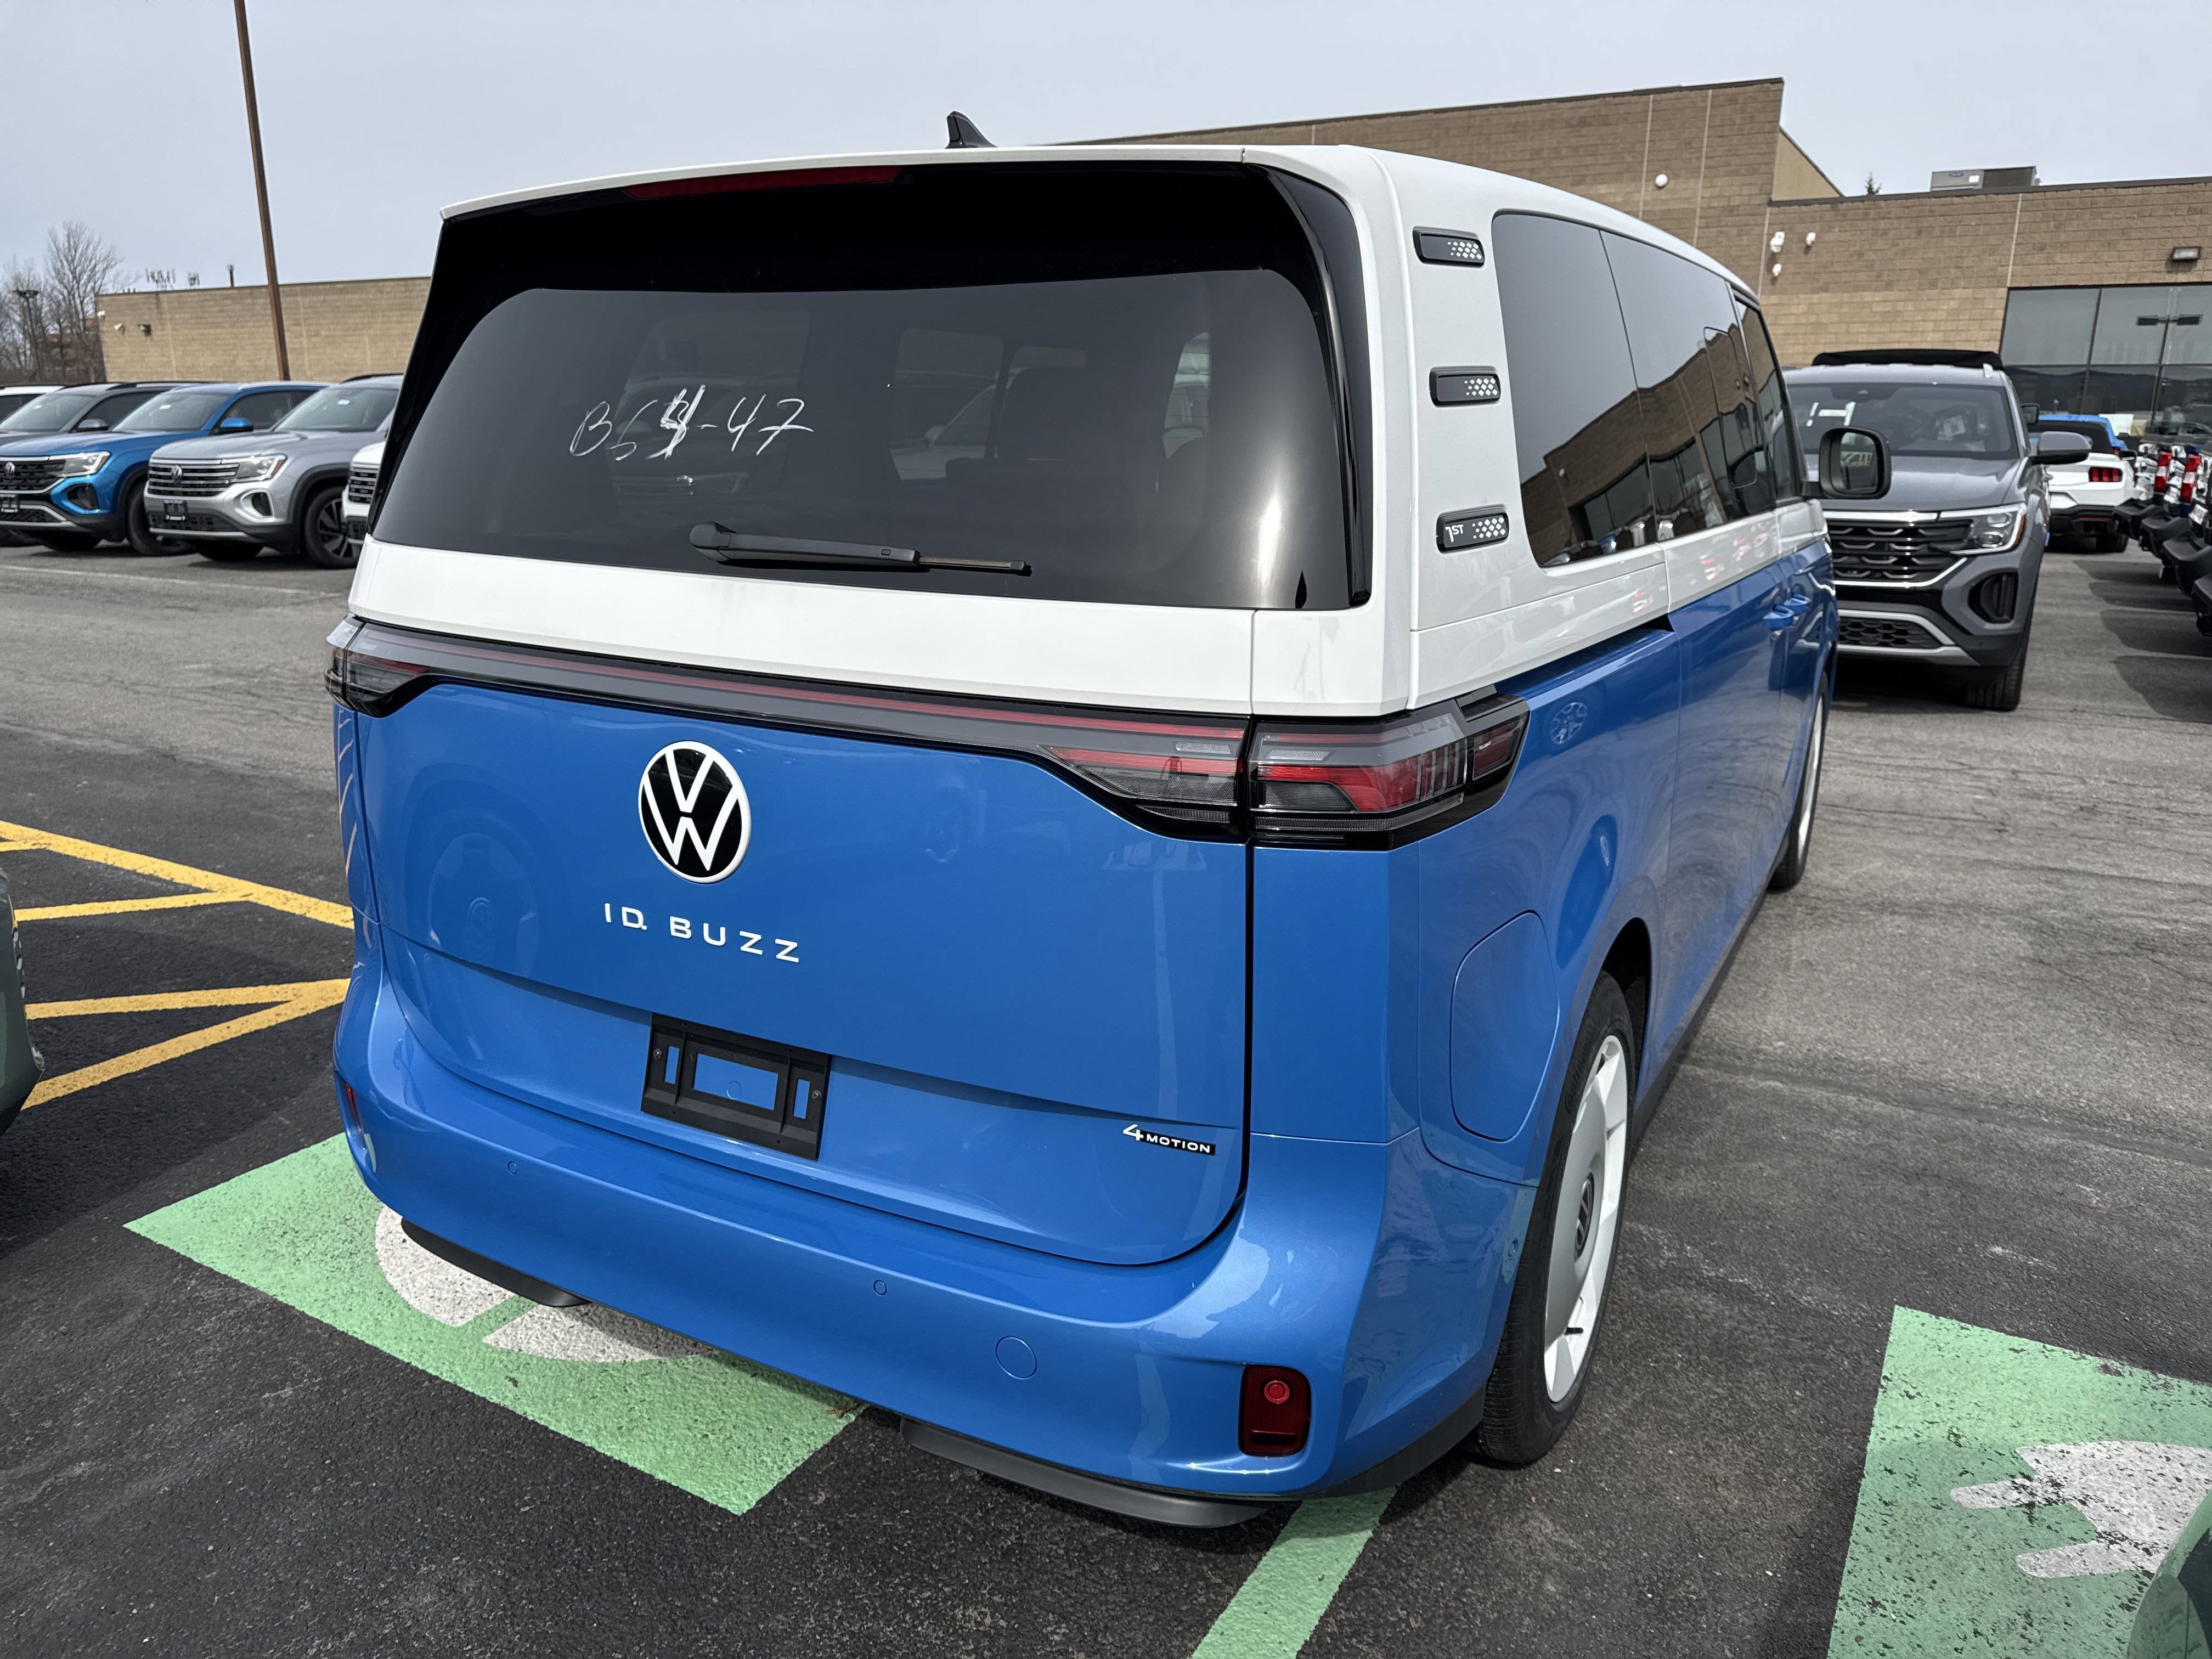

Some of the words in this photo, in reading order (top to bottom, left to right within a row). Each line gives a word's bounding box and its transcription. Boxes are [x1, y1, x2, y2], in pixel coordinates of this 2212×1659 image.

[1444, 524, 1464, 543] 1ST
[639, 741, 751, 883] VW
[669, 916, 800, 963] BUZZ
